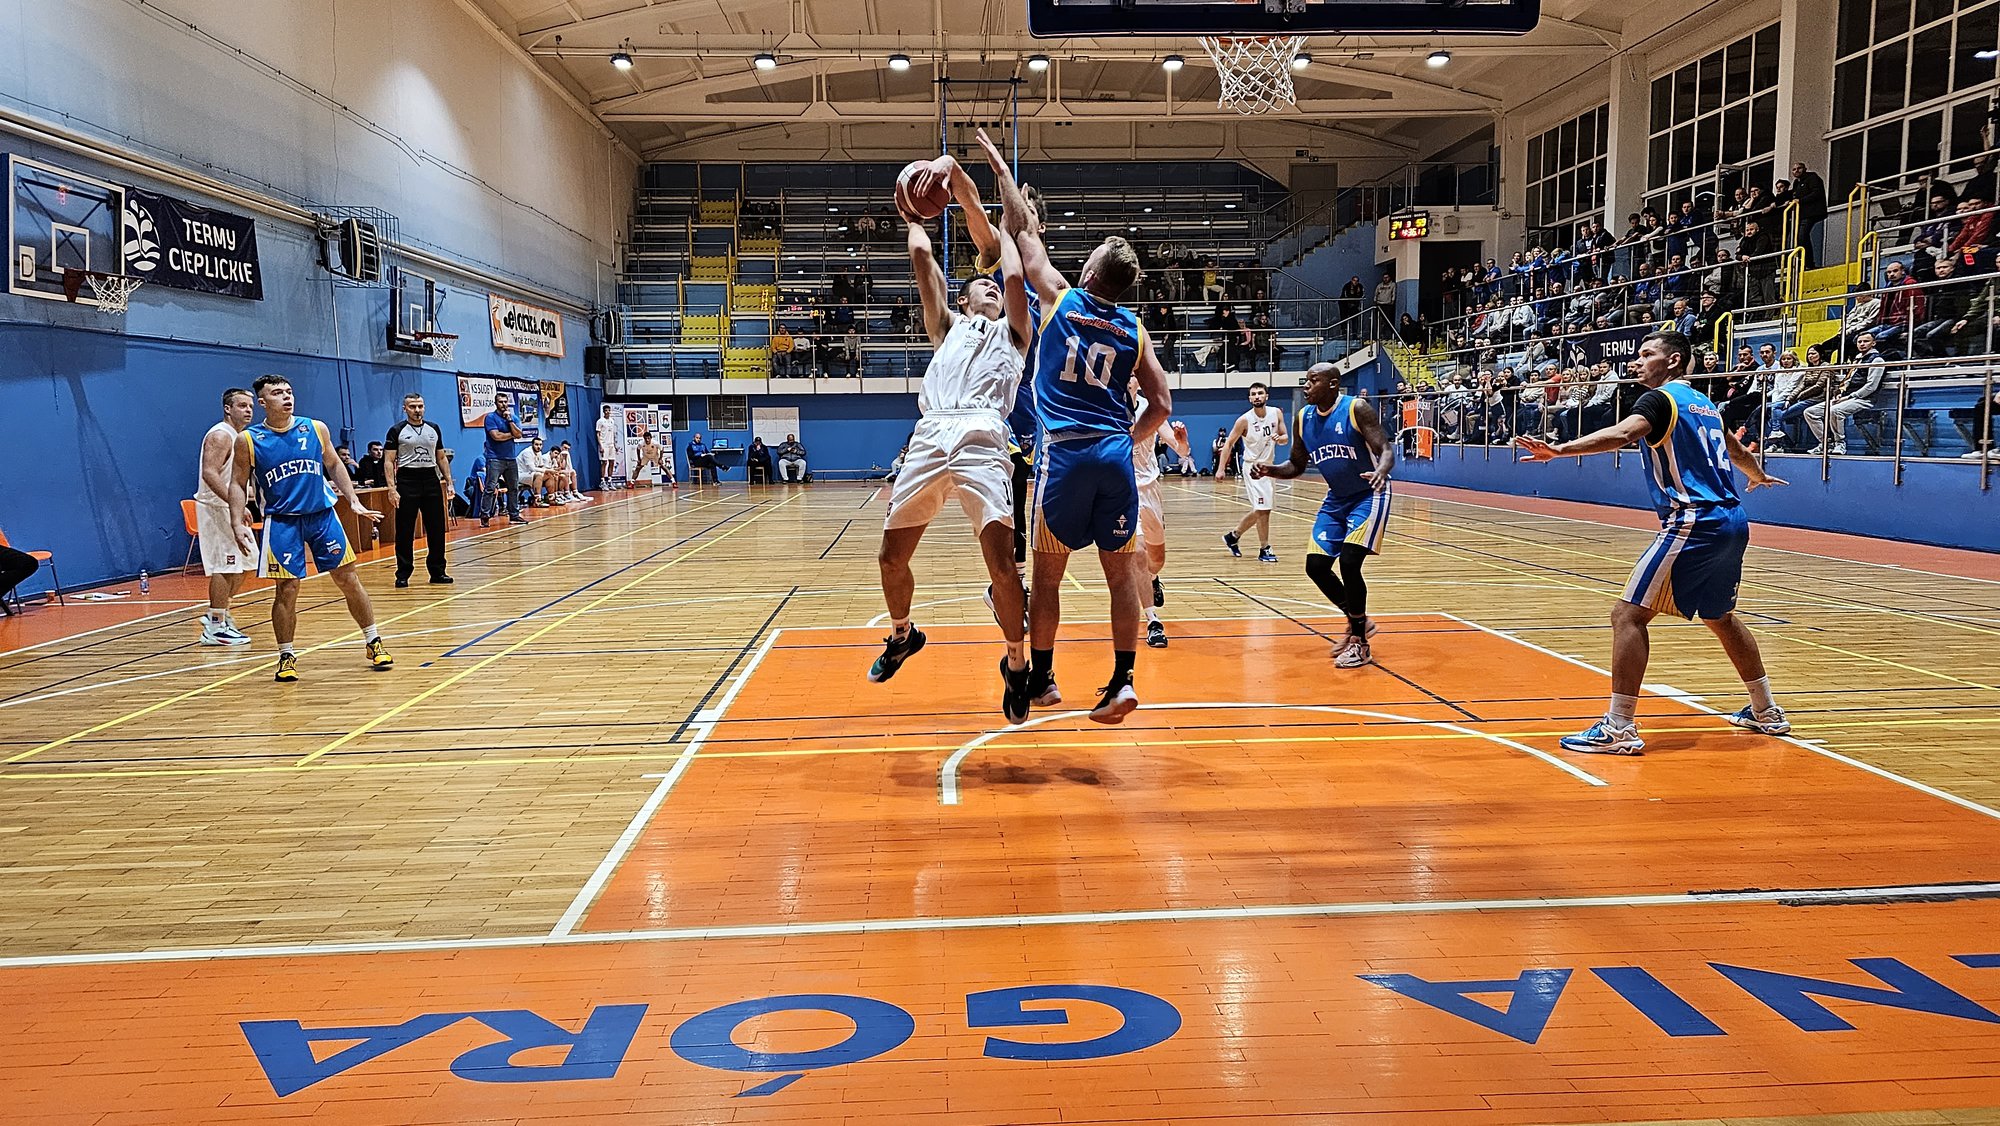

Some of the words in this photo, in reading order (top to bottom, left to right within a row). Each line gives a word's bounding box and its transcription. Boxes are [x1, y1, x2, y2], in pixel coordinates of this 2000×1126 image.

[182, 218, 236, 251] TERMY
[21, 253, 34, 277] D
[168, 246, 253, 284] CIEPLICKIE
[1600, 338, 1636, 358] TERMY
[1059, 335, 1117, 390] 10
[1334, 421, 1343, 435] 4
[297, 437, 308, 451] 7
[1697, 425, 1731, 472] 12
[1317, 530, 1327, 541] 4
[282, 552, 292, 566] 7
[1356, 953, 2000, 1044] NIA
[239, 984, 1182, 1097] GÓRA
